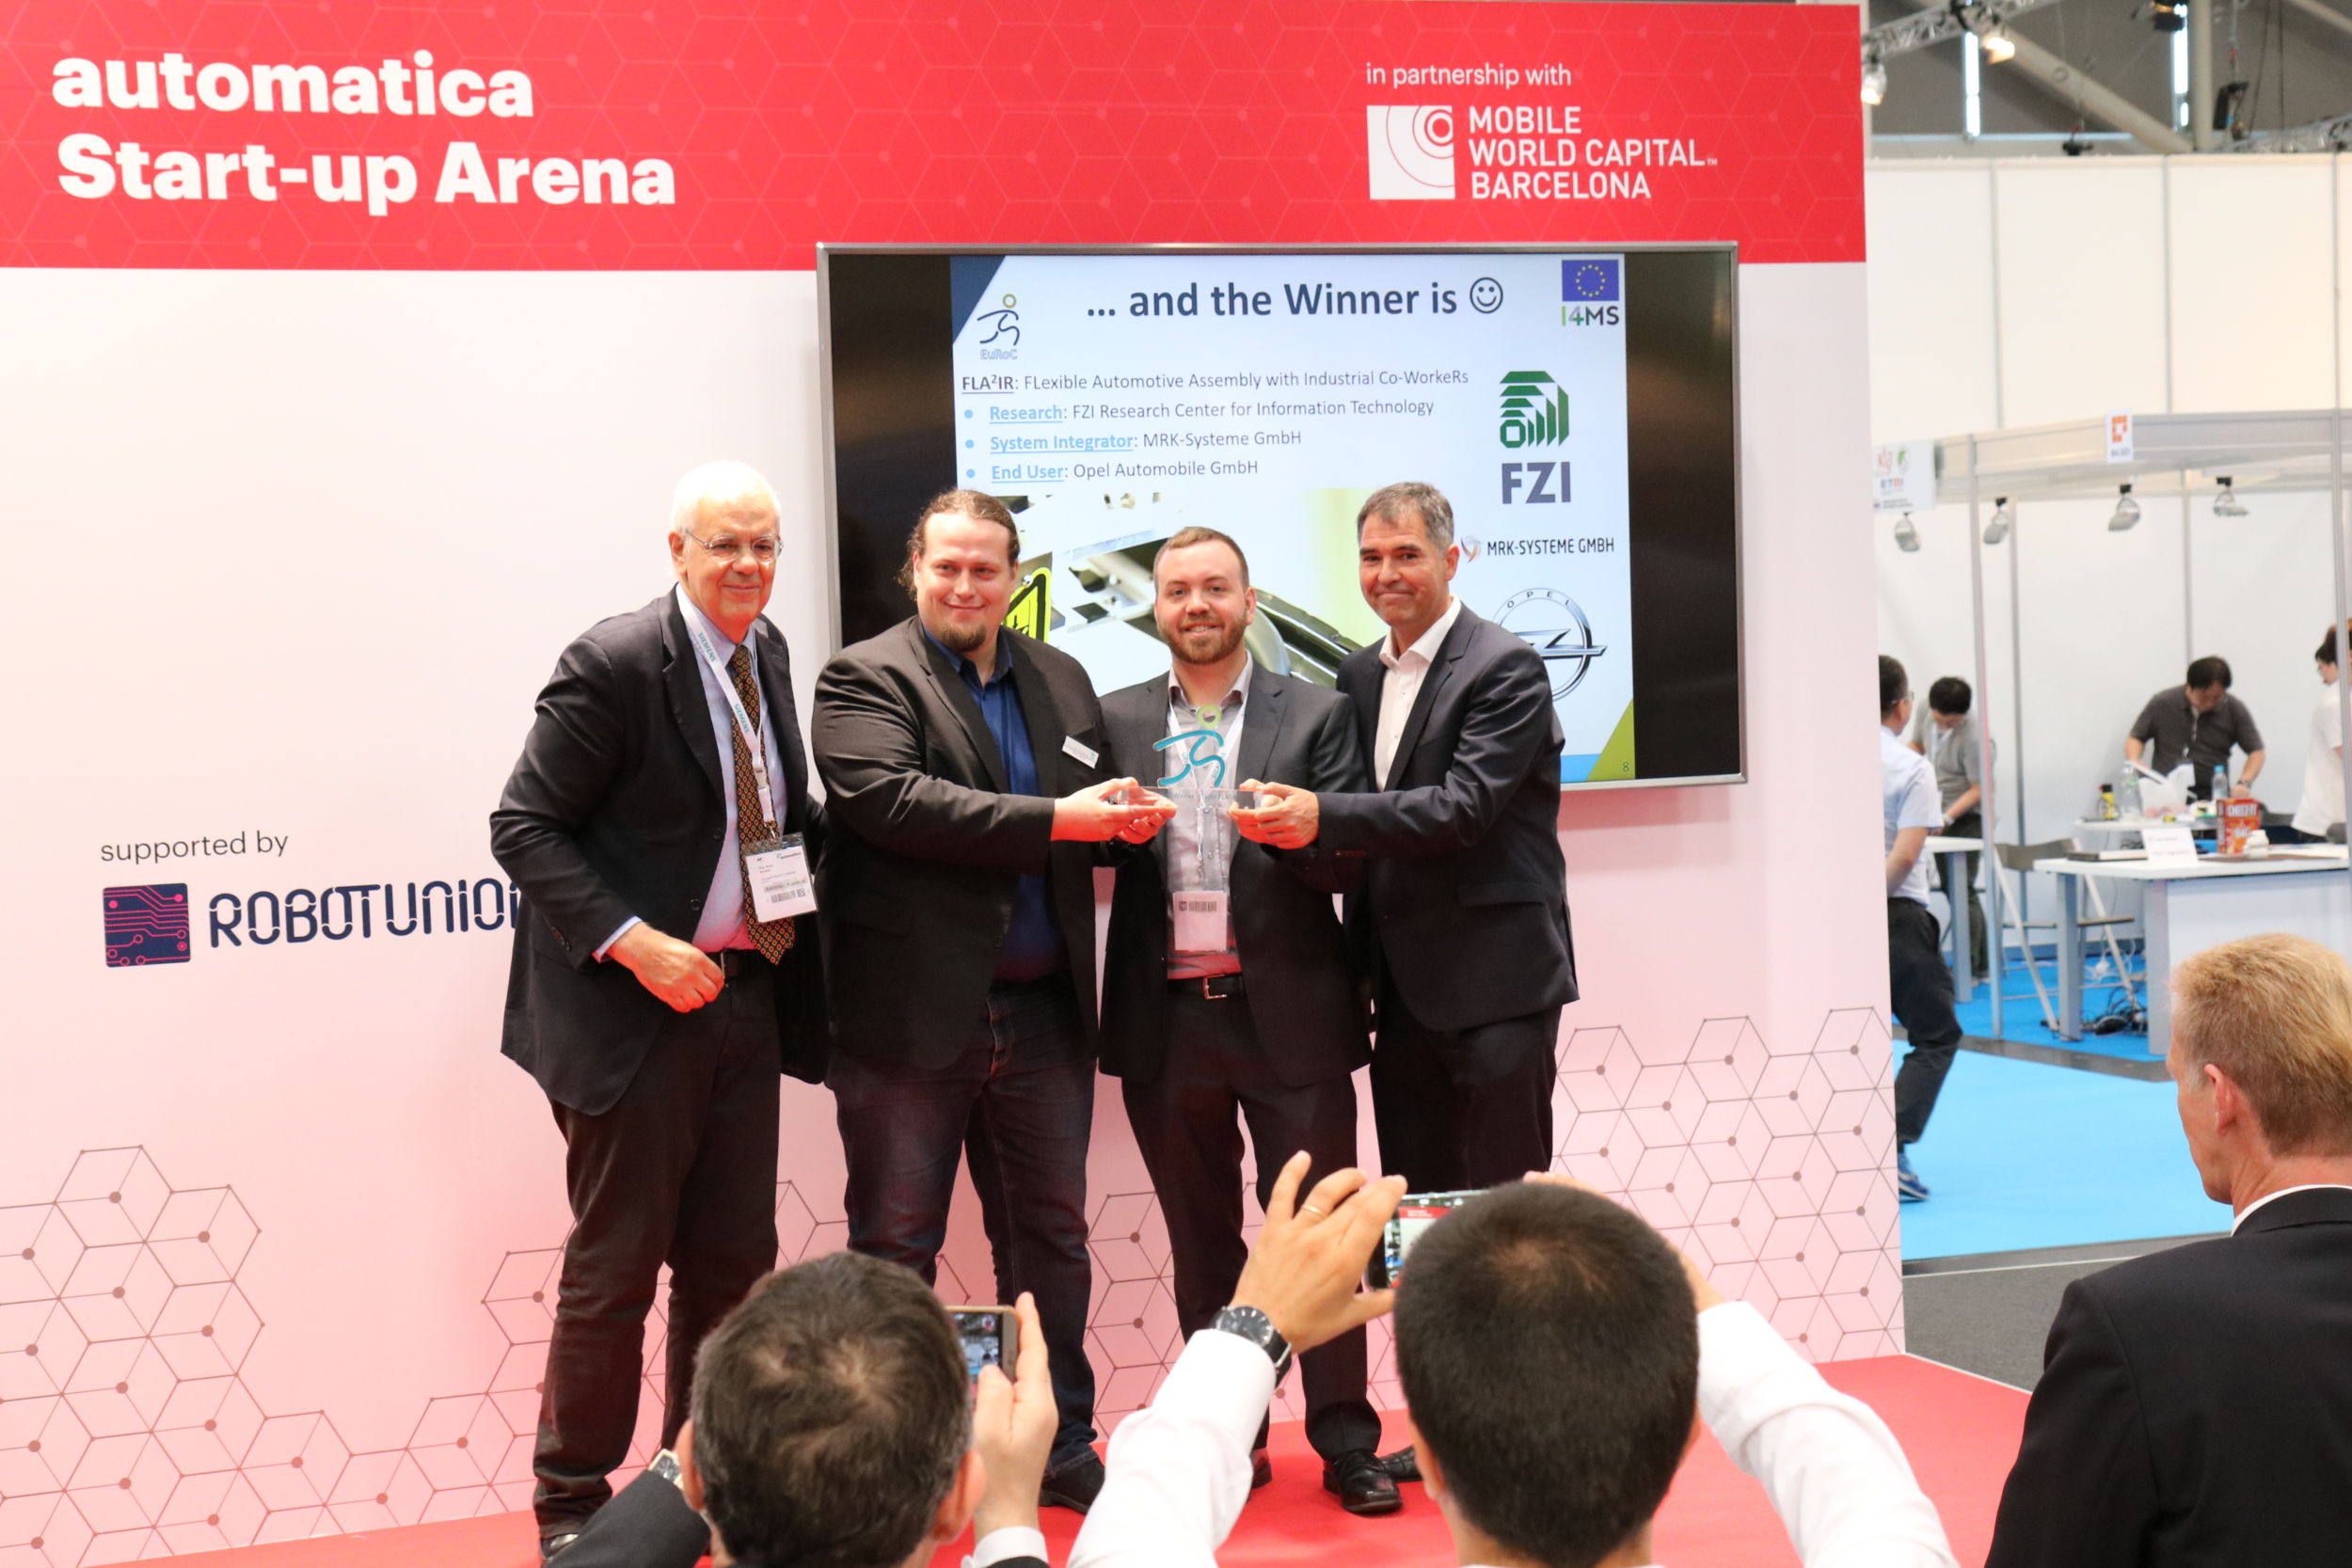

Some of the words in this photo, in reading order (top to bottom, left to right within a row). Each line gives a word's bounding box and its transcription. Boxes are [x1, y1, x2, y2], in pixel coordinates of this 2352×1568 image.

[52, 49, 534, 118] automatica
[1366, 62, 1386, 85] in
[1392, 62, 1519, 89] partnership
[1525, 63, 1572, 86] with
[1469, 105, 1581, 135] MOBILE
[1469, 138, 1577, 166] WORLD
[57, 133, 418, 216] Start-up
[435, 141, 675, 206] Arena
[1470, 171, 1651, 199] BARCELONA
[1129, 282, 1198, 317] and
[1211, 282, 1272, 316] the
[1283, 282, 1419, 315] Winner
[1432, 281, 1457, 314] is
[1561, 305, 1619, 326] I4MS
[979, 348, 1018, 360] EuRoC
[1024, 374, 1088, 390] FLexible
[1091, 373, 1184, 389] Automotive
[1188, 372, 1262, 390] Assembly
[1266, 372, 1299, 387] with
[1304, 371, 1375, 387] Industrial
[1378, 370, 1469, 386] Co-WorkeRs
[990, 404, 1068, 420] Research:
[1073, 404, 1095, 420] FZI
[1100, 403, 1169, 420] Research
[1175, 402, 1225, 419] Center
[1231, 401, 1251, 417] for
[1256, 400, 1346, 416] Information
[1350, 399, 1435, 417] Technology
[990, 436, 1049, 453] System
[1053, 434, 1137, 452] Integrator:
[1143, 432, 1249, 450] MRK-Systeme
[1254, 430, 1301, 446] GmbH
[992, 464, 1022, 480] End
[1026, 464, 1069, 479] User:
[1073, 462, 1110, 481] Opel
[1115, 460, 1206, 477] Automobile
[1210, 460, 1258, 475] GmbH
[1501, 461, 1571, 505] FZI
[1487, 538, 1574, 556] MRK-SYSTEME
[1578, 537, 1614, 553] GMBH
[1506, 590, 1570, 610] OPEL
[1622, 761, 1629, 772] 8
[101, 831, 246, 864] supported
[257, 830, 289, 857] by
